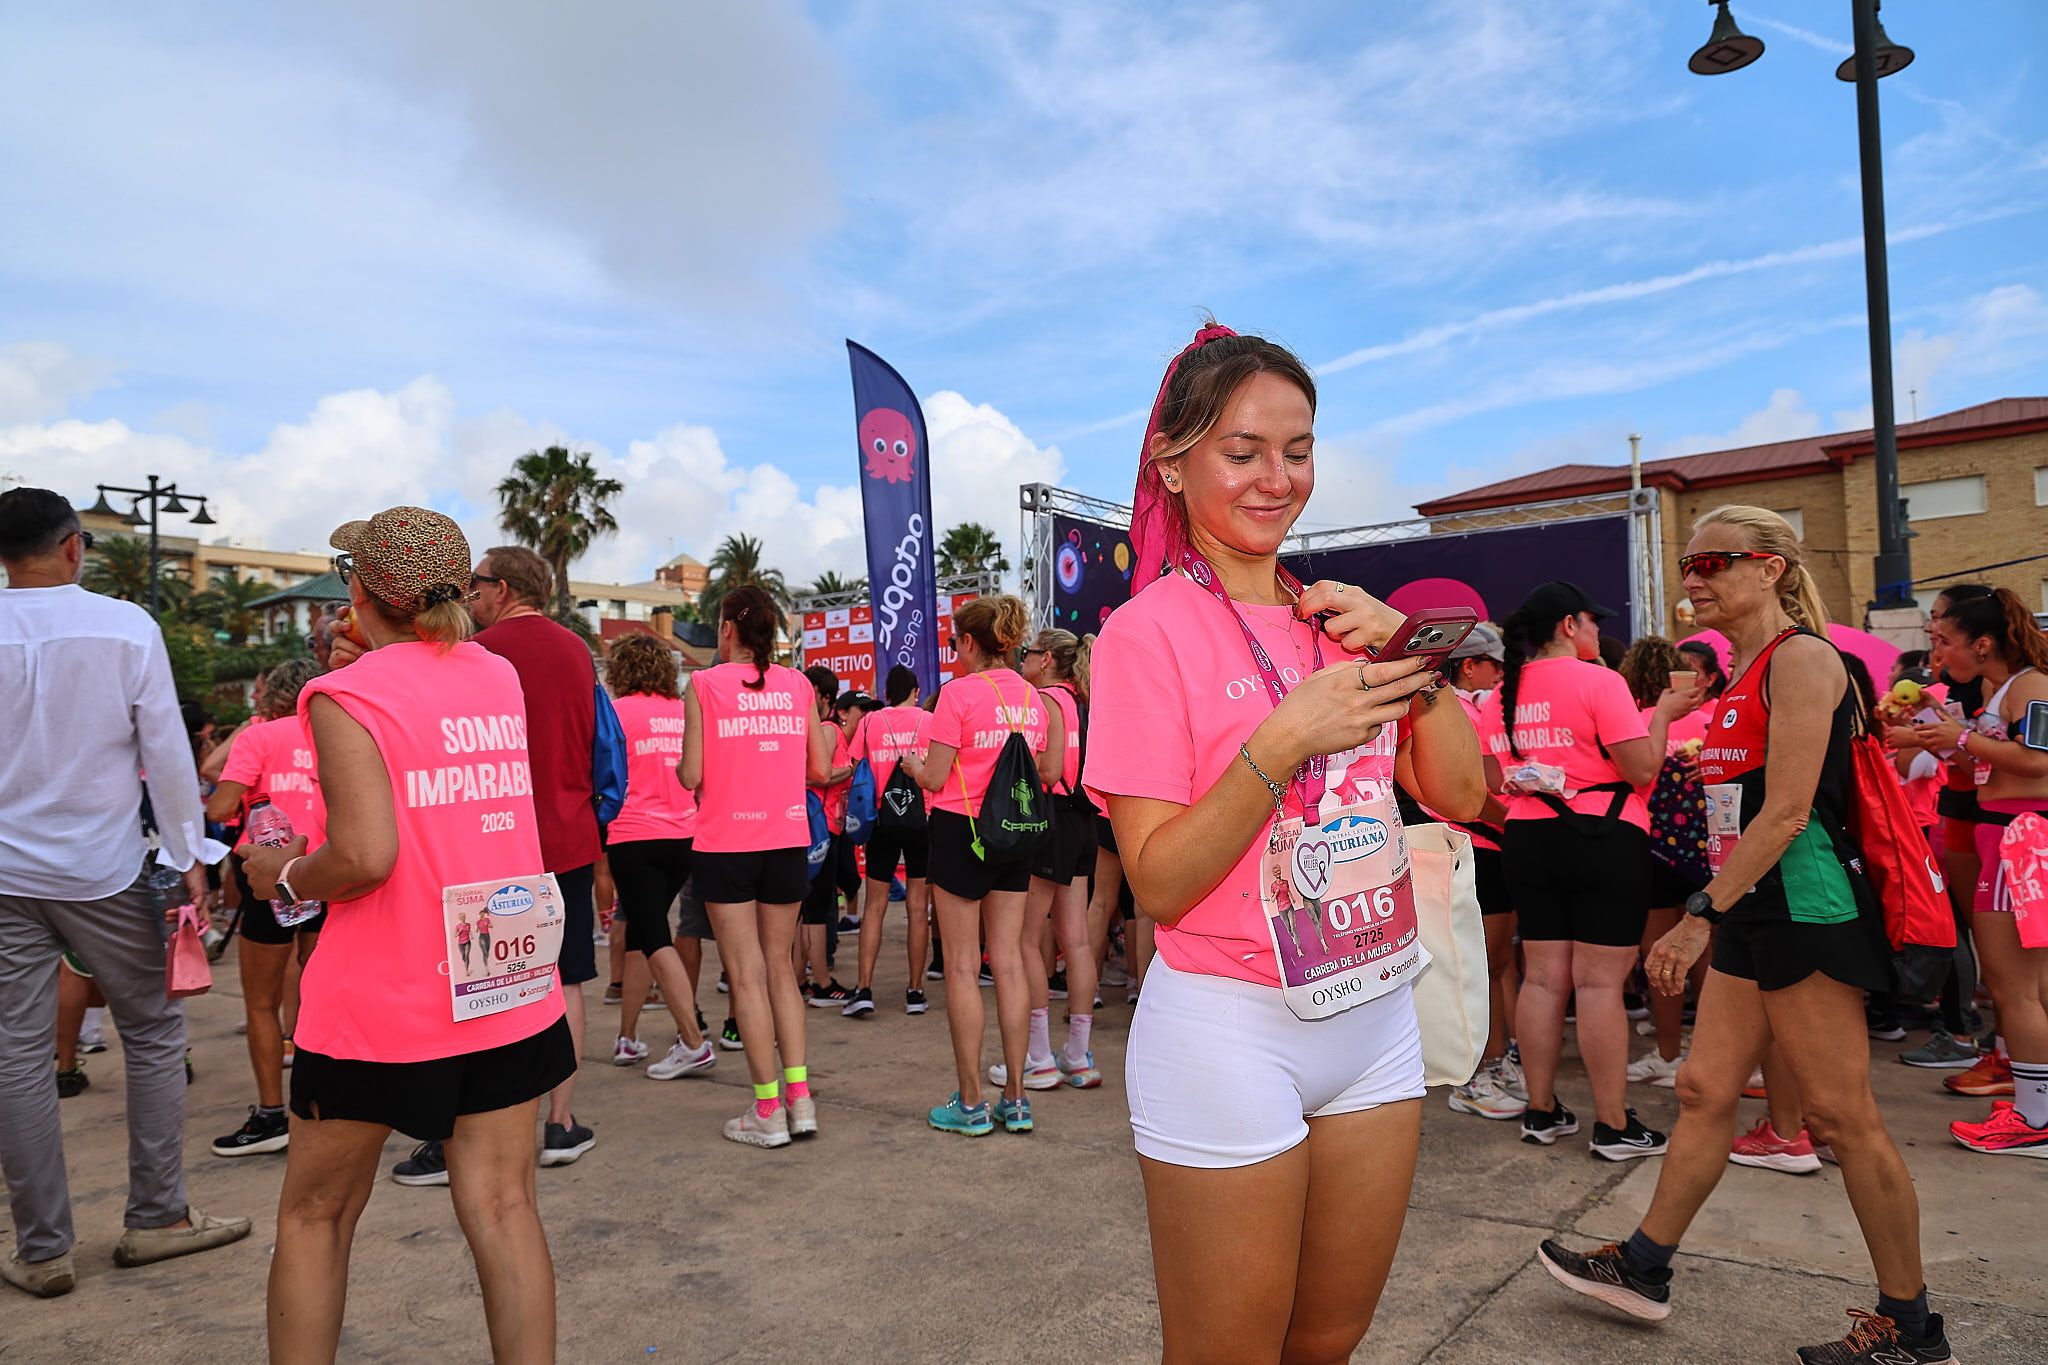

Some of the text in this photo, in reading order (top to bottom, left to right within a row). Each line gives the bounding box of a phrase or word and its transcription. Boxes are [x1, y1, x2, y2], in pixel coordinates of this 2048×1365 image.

[1226, 667, 1299, 701] OYSO
[737, 691, 793, 711] SOMOS
[996, 705, 1039, 726] SOMOS
[441, 714, 528, 755] SOMOS
[759, 741, 779, 752] 2026
[1721, 748, 1748, 761] WAY
[481, 811, 515, 834] 2026
[733, 810, 767, 820] OYSHO
[1328, 831, 1351, 841] ENTRAL
[1331, 831, 1385, 853] TURIANA
[457, 895, 485, 906] SUMA
[1327, 887, 1395, 932] 016
[494, 935, 536, 961] 016
[1353, 928, 1383, 948] 2725
[507, 961, 526, 974] 5256
[1304, 960, 1339, 981] CARRERA
[1340, 956, 1354, 968] DE
[1354, 953, 1366, 963] LA
[1367, 943, 1392, 959] MUJER
[466, 979, 496, 993] CARRERA
[496, 977, 505, 986] DE
[505, 976, 513, 985] LA
[1313, 977, 1362, 1006] OYSHO
[469, 993, 508, 1011] OYSHO
